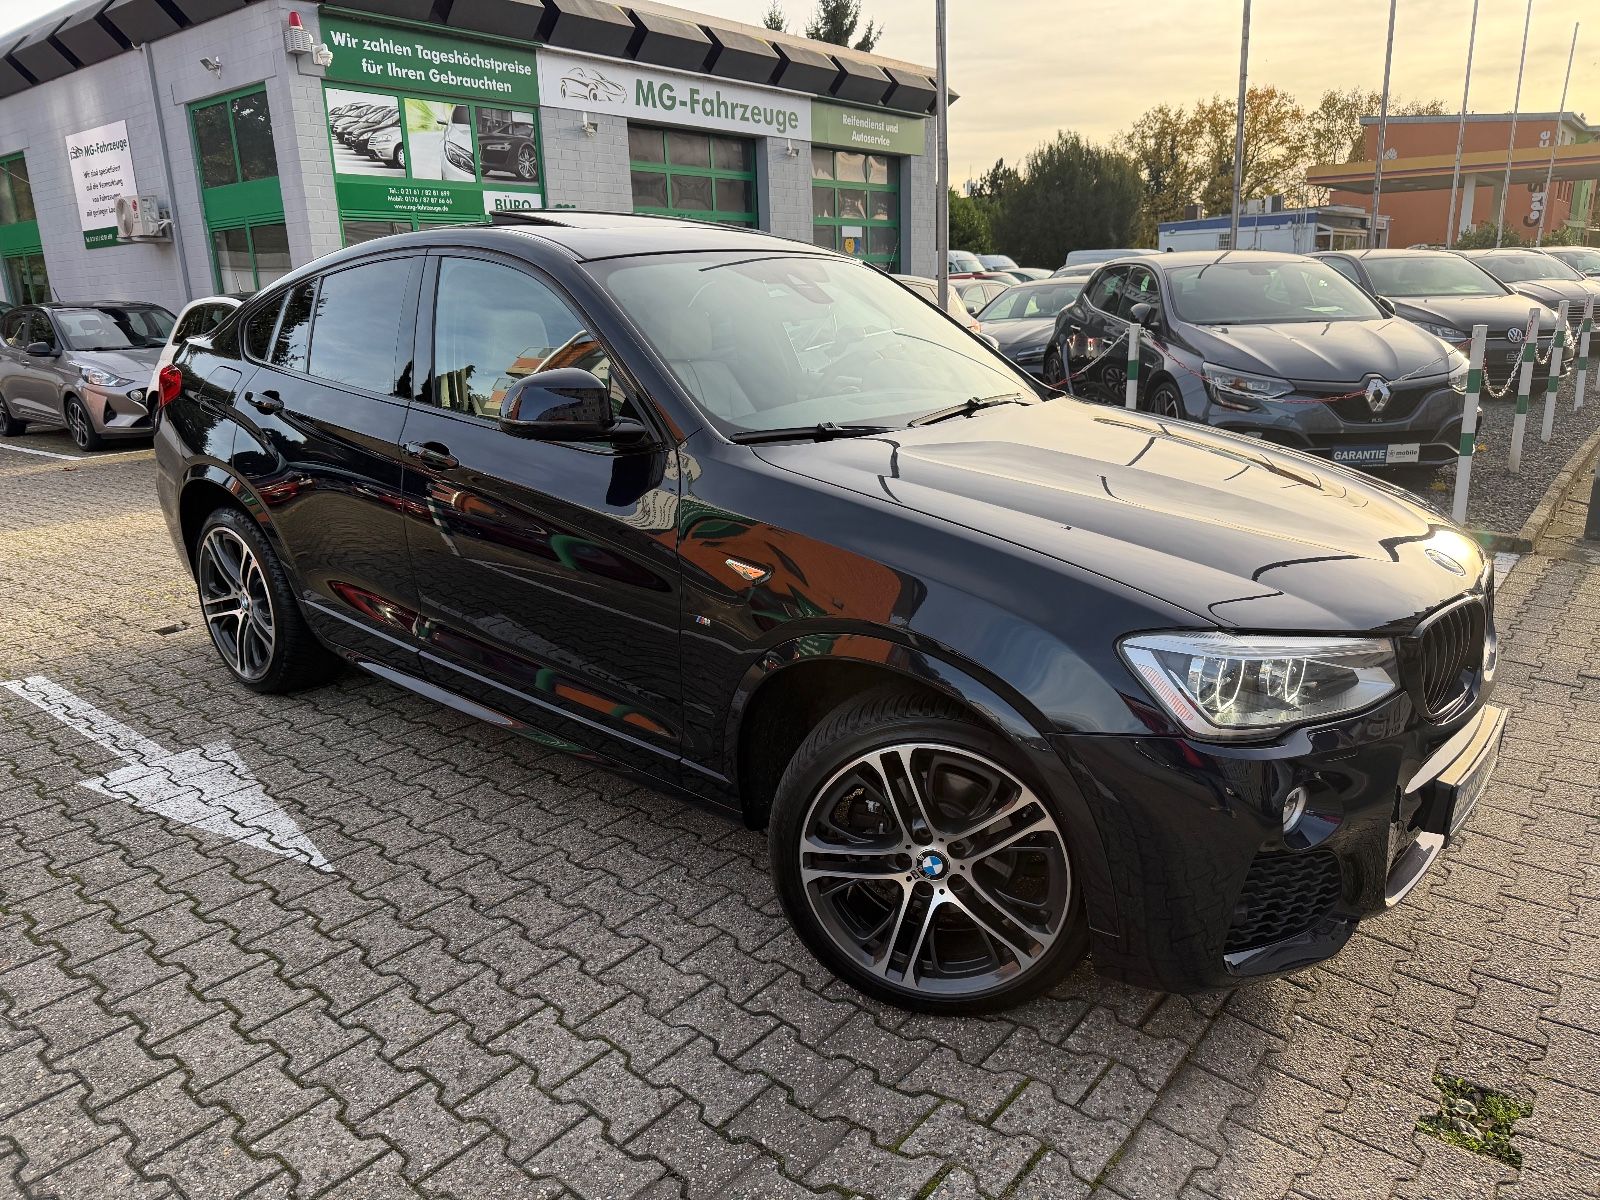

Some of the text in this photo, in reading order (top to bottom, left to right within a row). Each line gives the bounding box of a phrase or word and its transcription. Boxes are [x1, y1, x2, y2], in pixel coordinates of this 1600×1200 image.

[330, 30, 532, 76] Wir zahlen Tageshöchstpreise
[361, 57, 513, 93] für Ihren Gebrauchten
[635, 78, 799, 134] MG-Fahrzeuge
[842, 113, 899, 134] Reifendienst und
[84, 139, 128, 157] MG-Fahrzeuge
[851, 130, 891, 147] Autoservice
[495, 195, 532, 210] BÜRO
[1333, 449, 1418, 461] GARANTIE mobile
